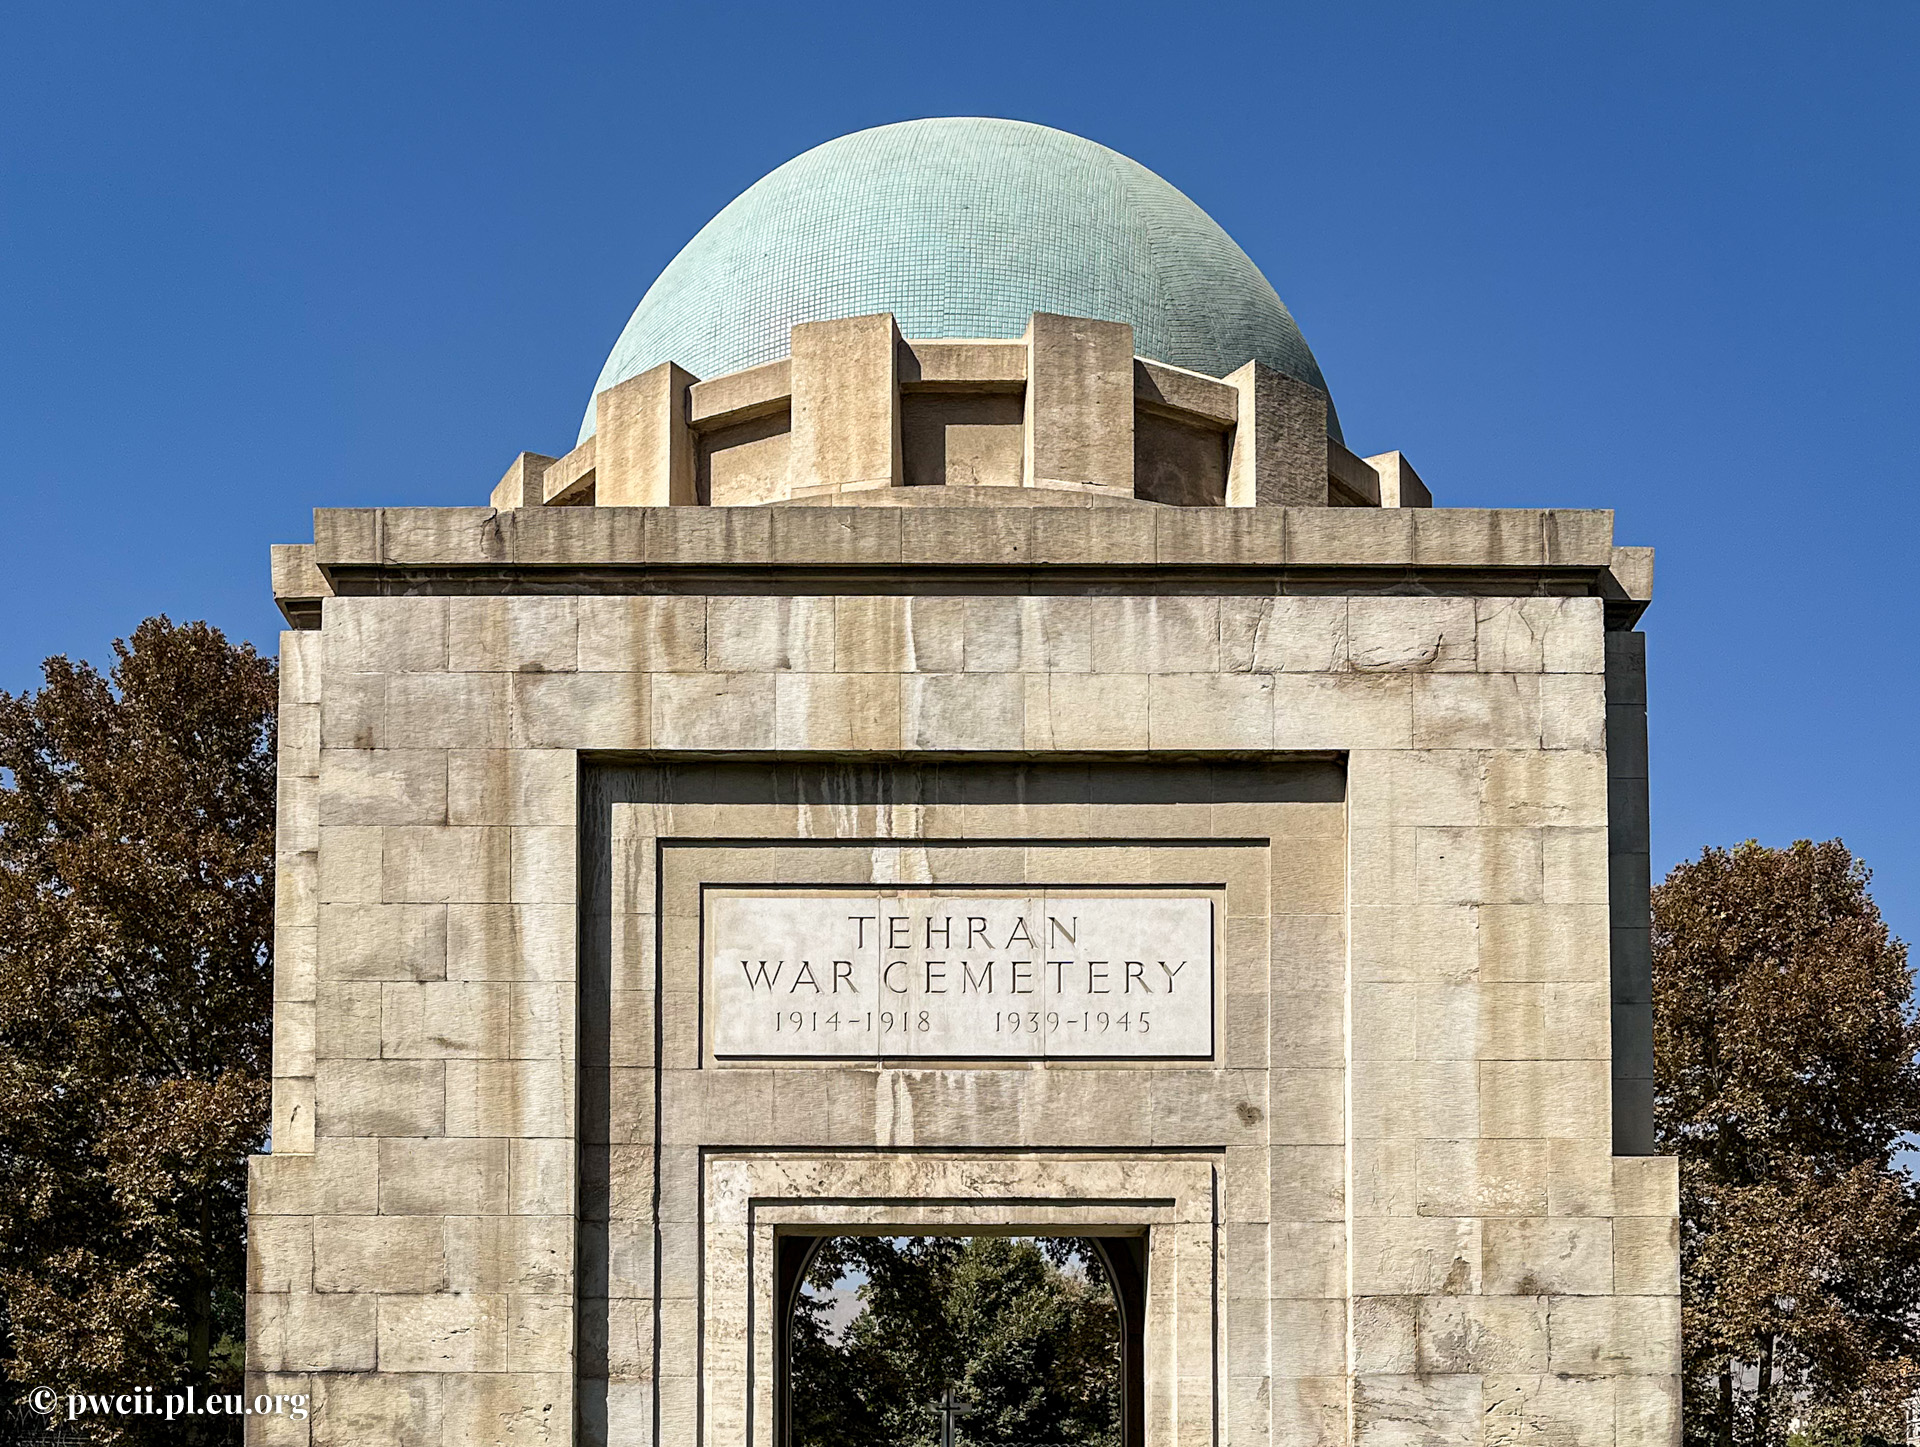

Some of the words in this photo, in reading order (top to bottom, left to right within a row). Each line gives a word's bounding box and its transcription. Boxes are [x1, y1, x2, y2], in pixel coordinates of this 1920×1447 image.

[848, 916, 1079, 950] TEHRAN
[741, 960, 861, 995] WAR
[883, 960, 1189, 995] CEMETERY
[775, 1010, 932, 1034] 1914-1918
[995, 1010, 1152, 1034] 1939-1945
